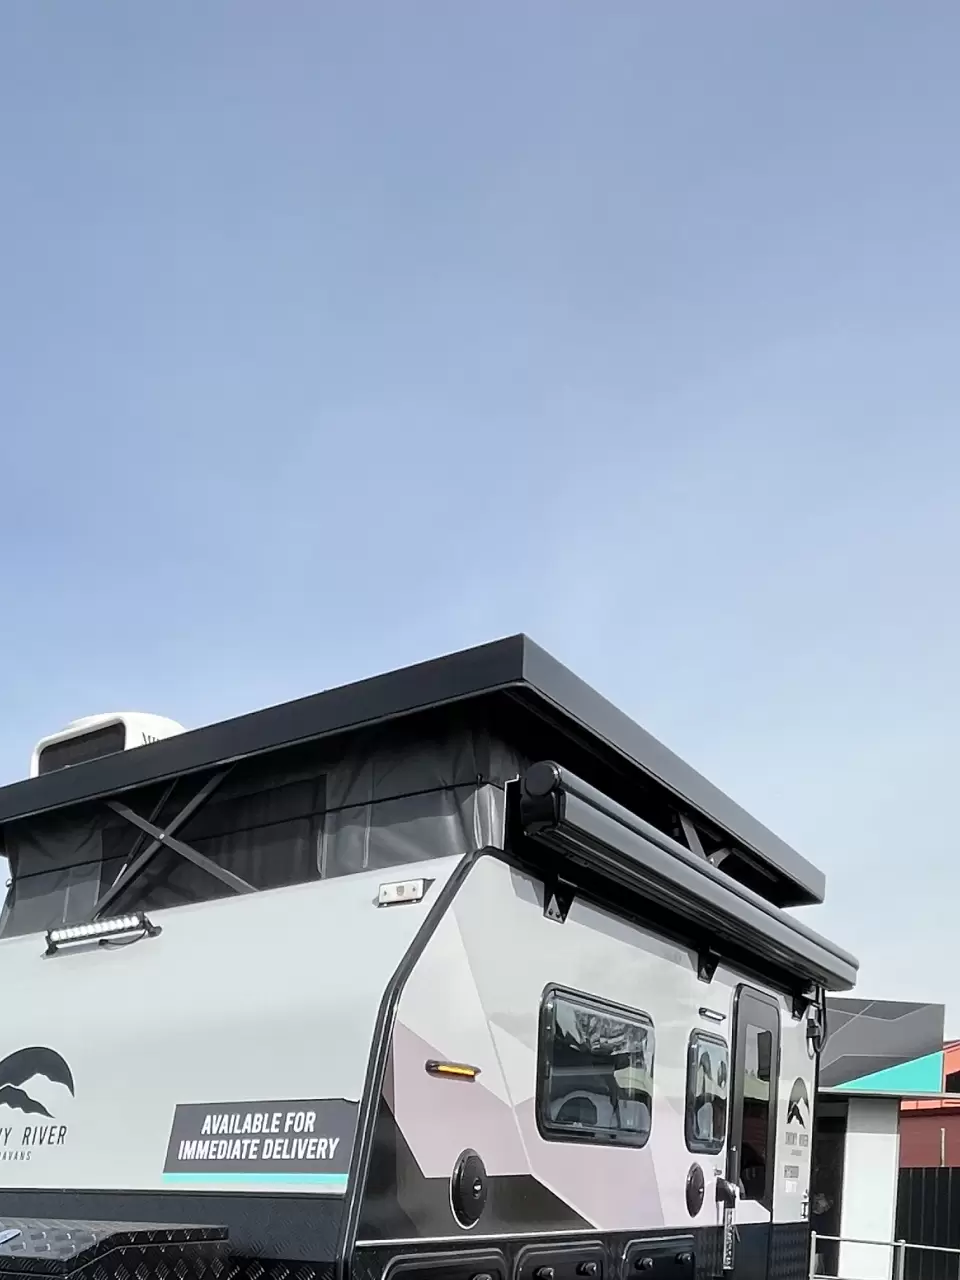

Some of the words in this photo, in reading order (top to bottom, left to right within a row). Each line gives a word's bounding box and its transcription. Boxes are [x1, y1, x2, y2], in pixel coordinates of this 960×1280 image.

[201, 1112, 283, 1135] AVAILABLE
[284, 1111, 317, 1133] FOR
[21, 1125, 67, 1146] RIVER
[177, 1138, 259, 1160] IMMEDIATE
[262, 1137, 340, 1160] DELIVERY
